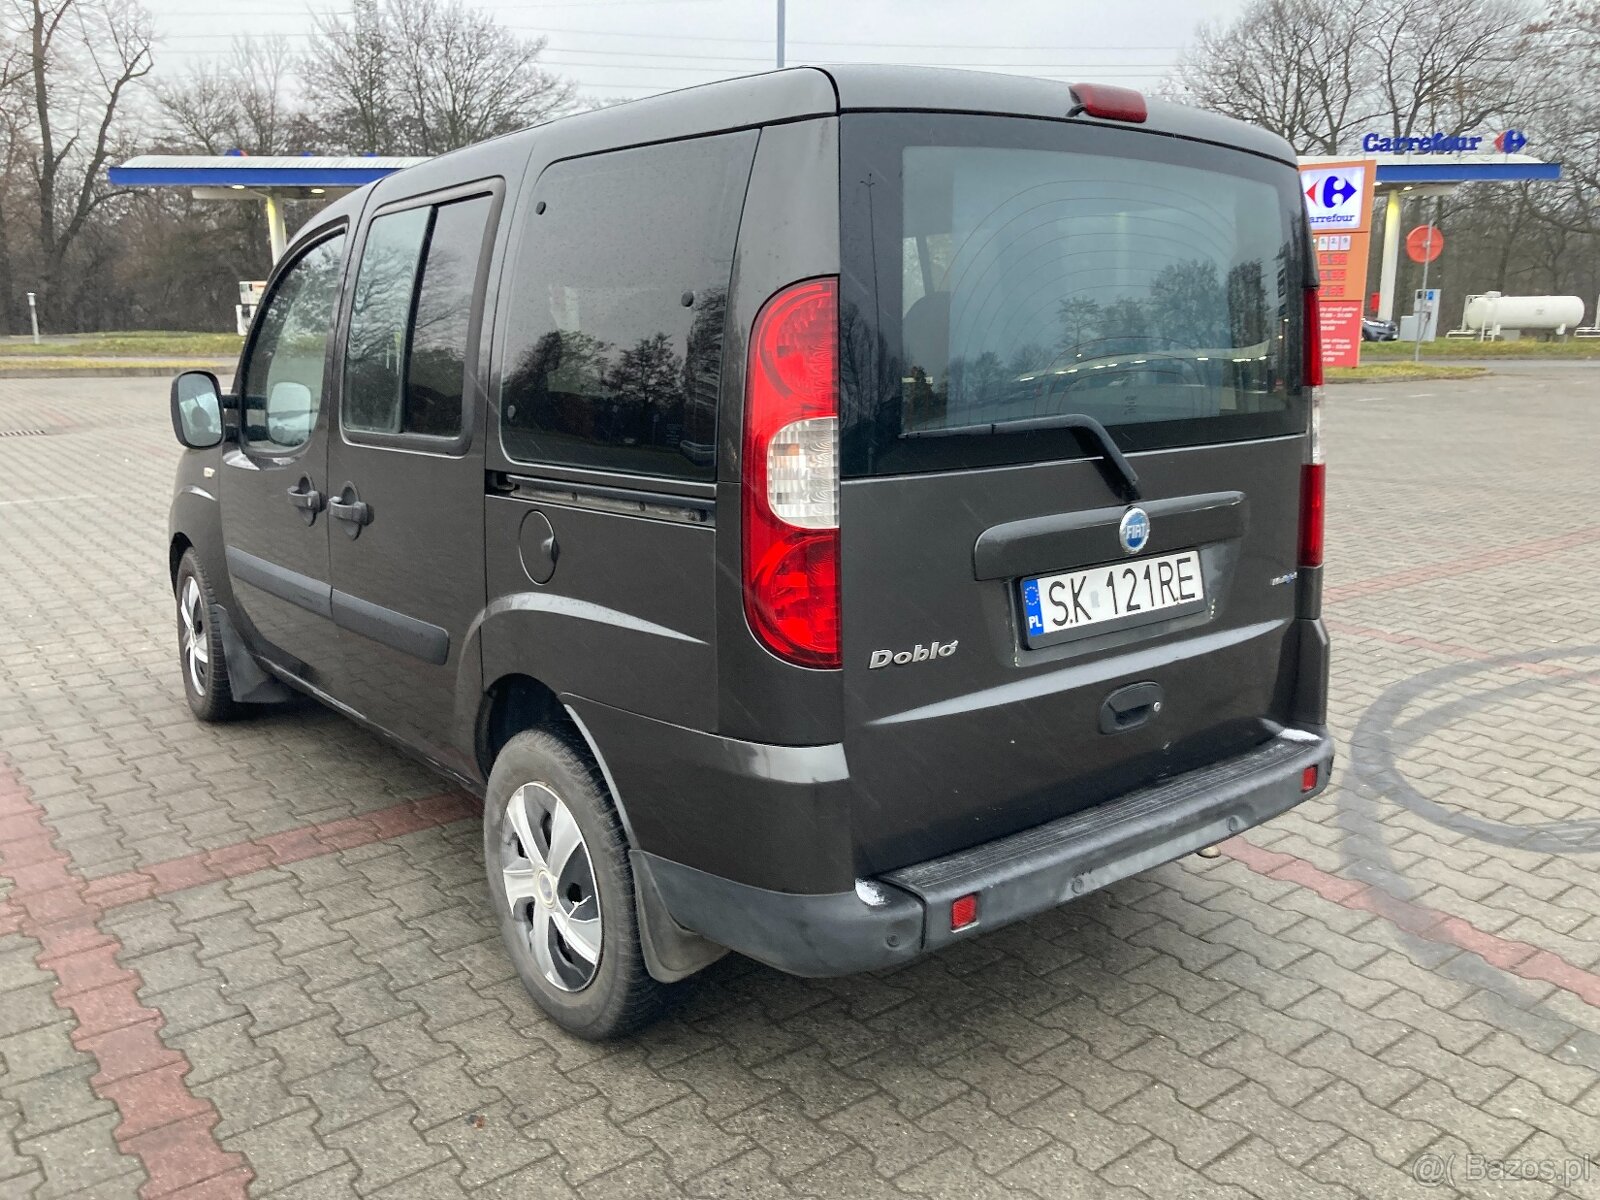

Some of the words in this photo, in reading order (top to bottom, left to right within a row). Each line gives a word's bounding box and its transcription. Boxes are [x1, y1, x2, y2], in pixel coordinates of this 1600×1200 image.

[1363, 132, 1483, 153] Carrefour
[1309, 213, 1355, 224] arrefour
[1126, 523, 1146, 539] FIAT
[1106, 556, 1196, 615] 121RE
[1028, 615, 1042, 630] PL
